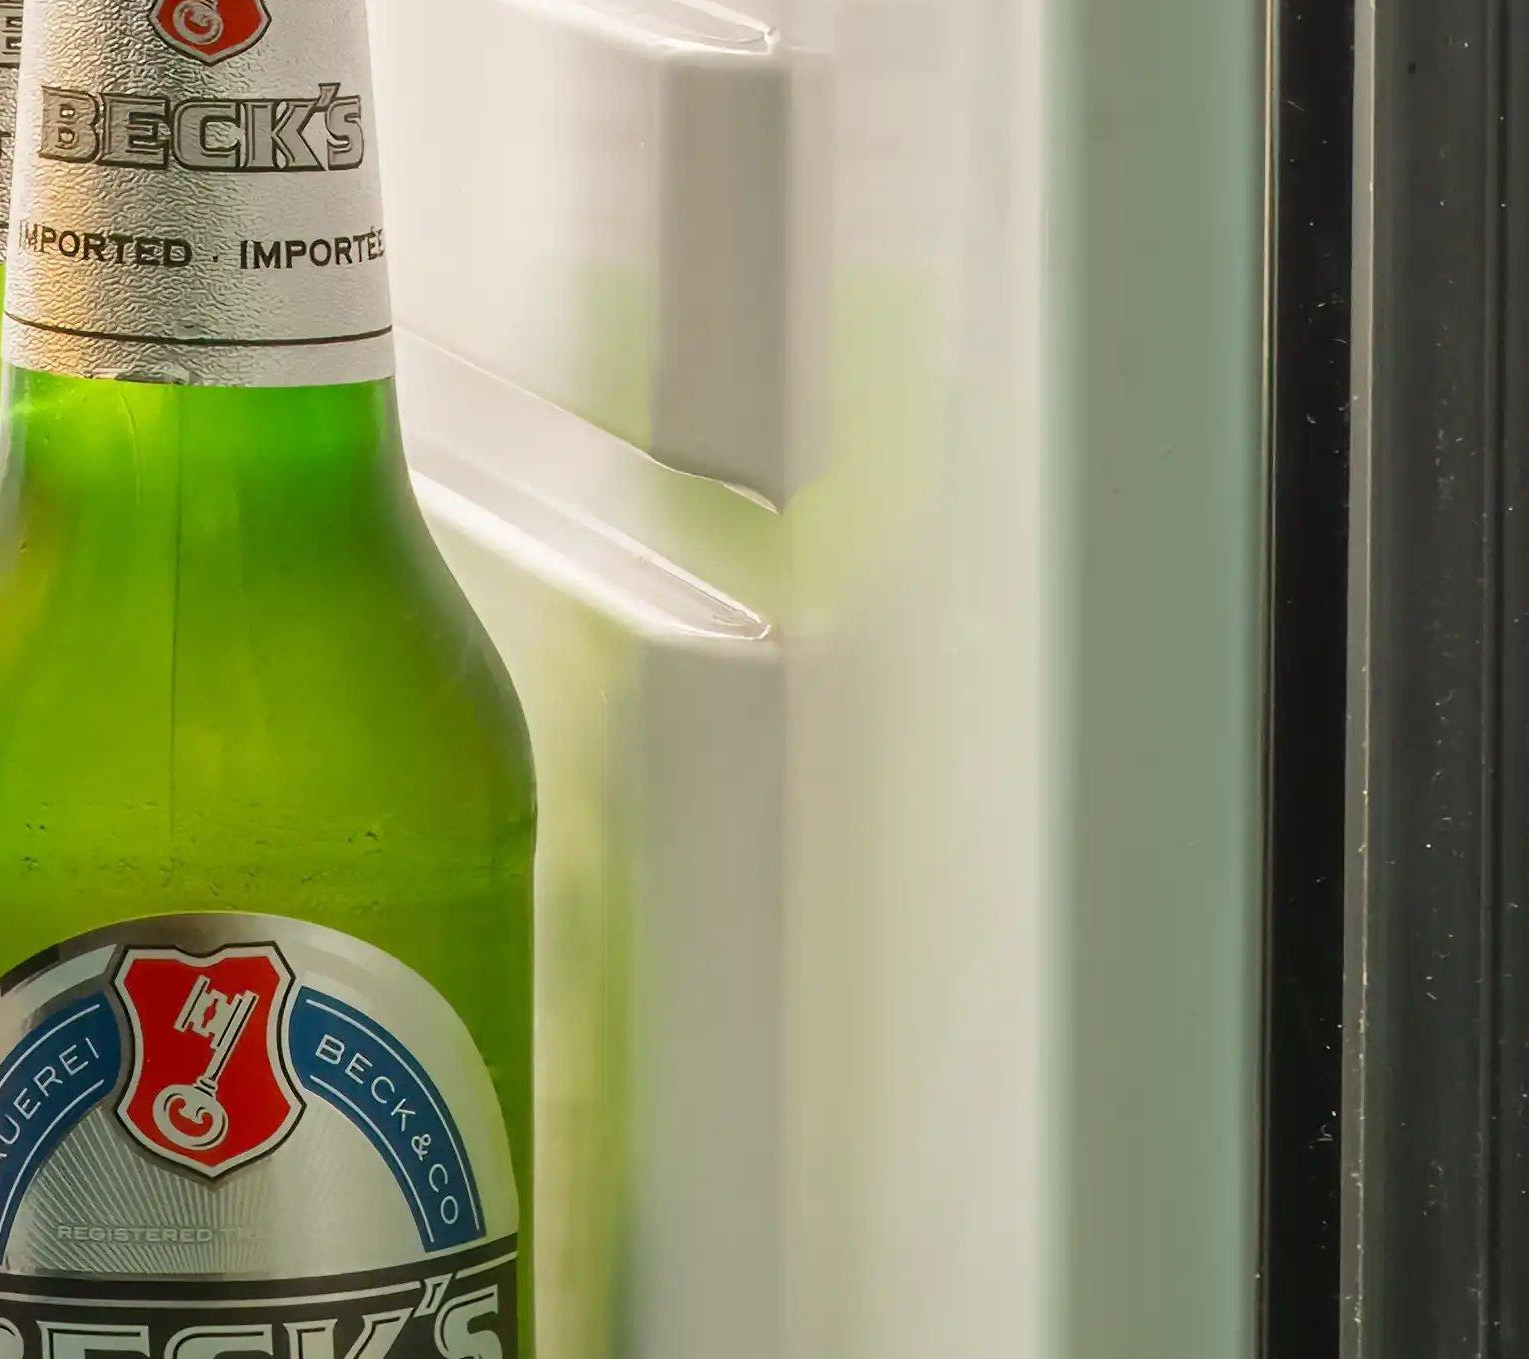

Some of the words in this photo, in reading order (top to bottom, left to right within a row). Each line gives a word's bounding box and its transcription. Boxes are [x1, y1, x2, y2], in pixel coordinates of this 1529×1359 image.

[37, 81, 367, 173] BECK'S
[18, 217, 194, 270] IMPORTED
[57, 1225, 213, 1243] REGISTERED
